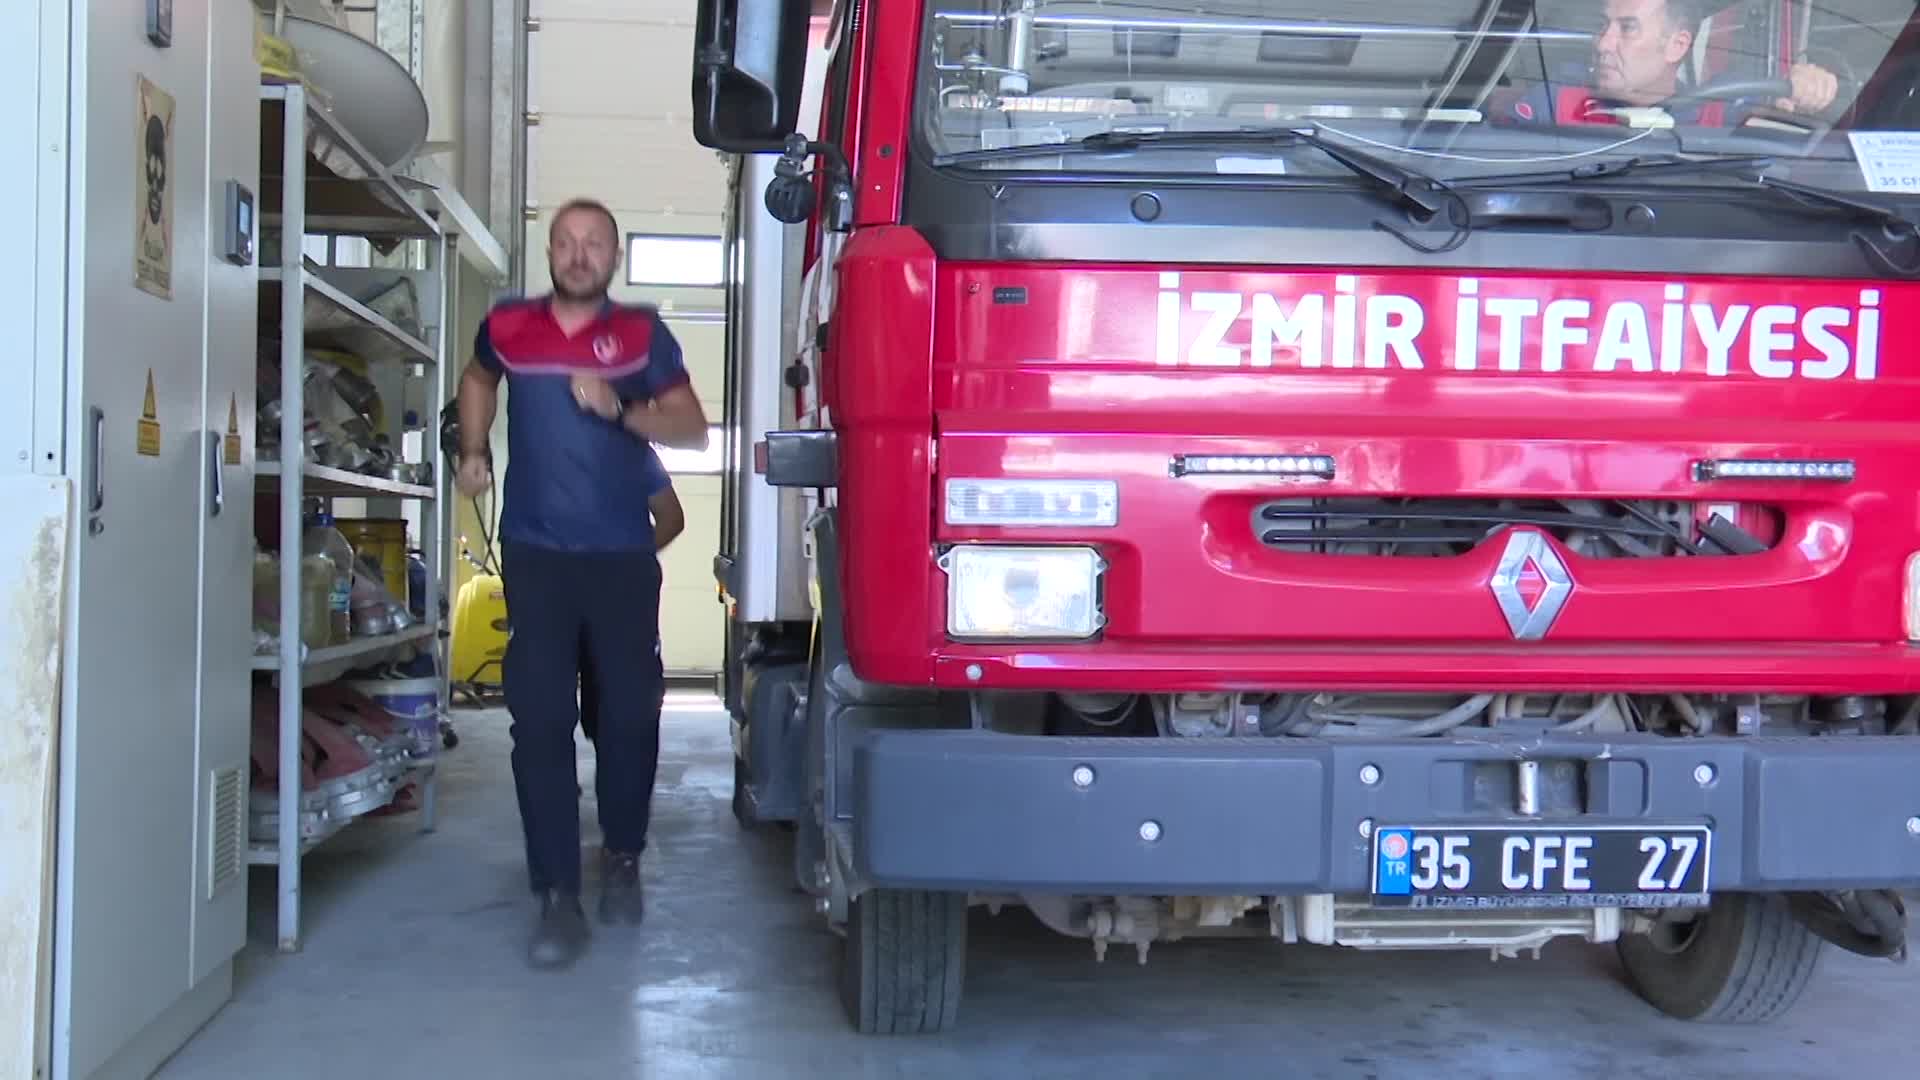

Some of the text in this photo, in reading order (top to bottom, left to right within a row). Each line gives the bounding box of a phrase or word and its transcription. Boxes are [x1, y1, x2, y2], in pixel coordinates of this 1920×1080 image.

[1156, 272, 1880, 380] İZMİR İTFAİYESİ
[1386, 861, 1407, 876] TR
[1411, 836, 1699, 890] 35 CFE 27
